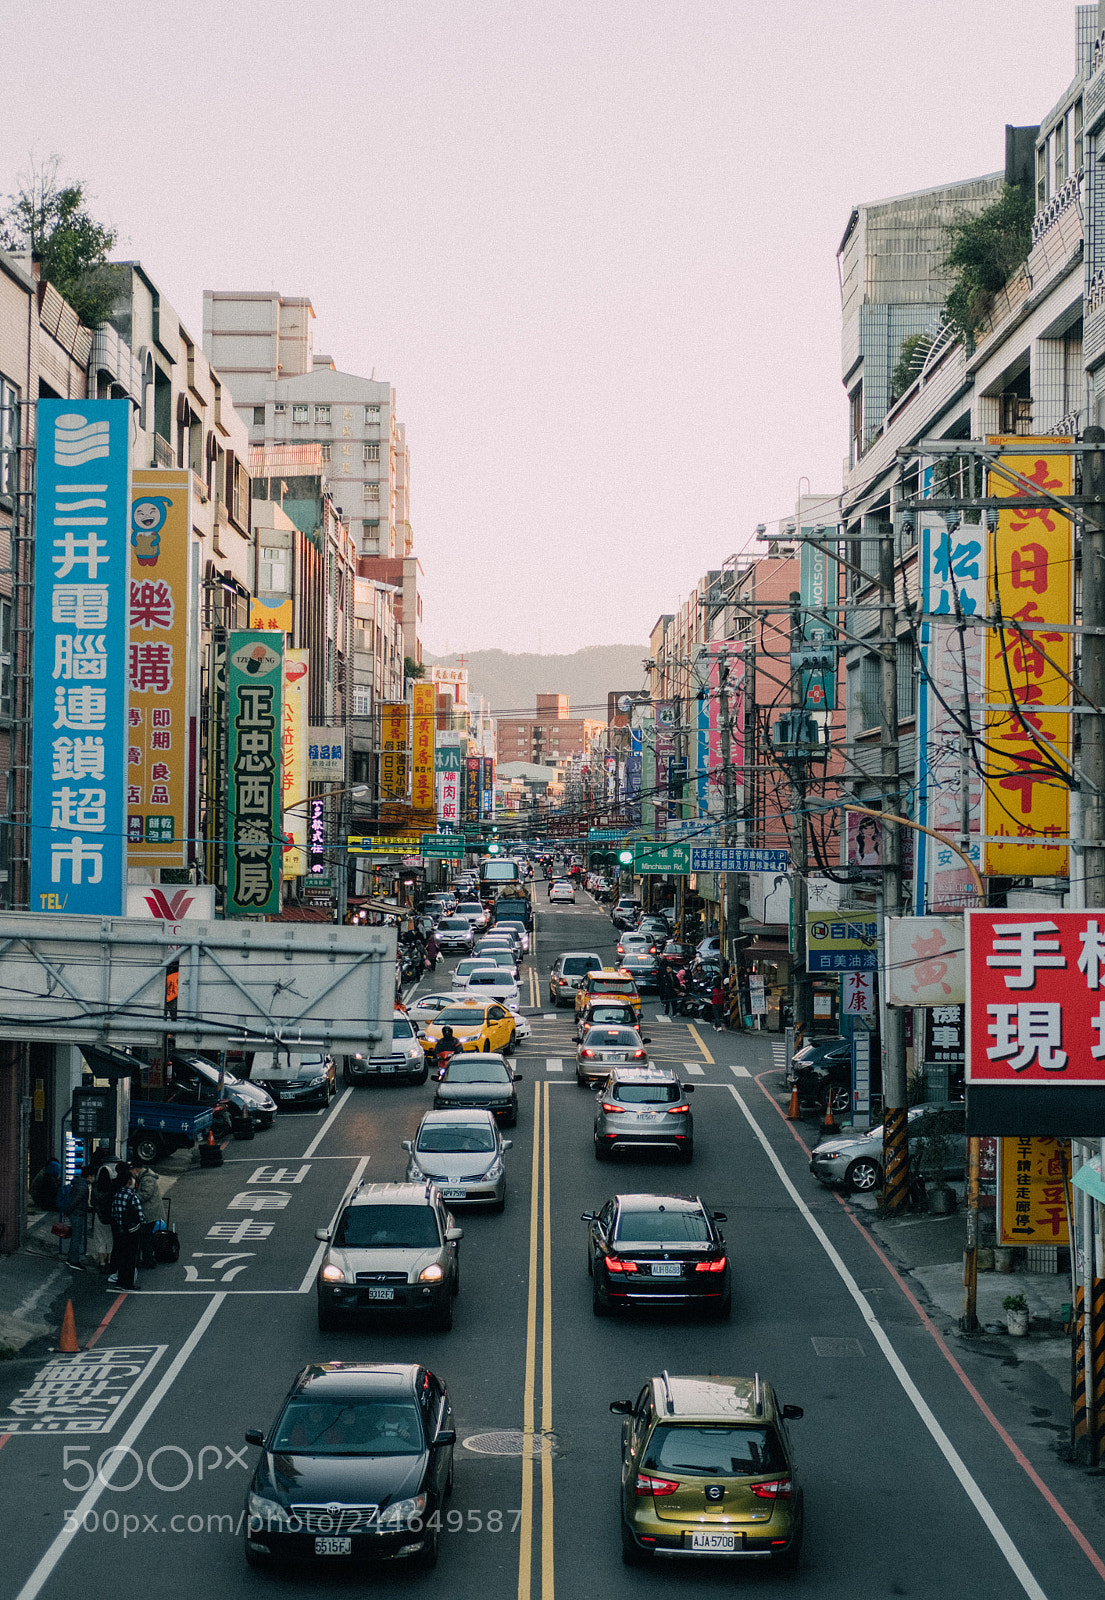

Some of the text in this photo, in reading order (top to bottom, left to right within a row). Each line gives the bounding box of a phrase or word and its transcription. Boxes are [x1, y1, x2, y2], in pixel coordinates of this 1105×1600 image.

[51, 484, 109, 885] 三井電腦連鎖超市
[994, 459, 1065, 814] 黃日香豆干
[237, 687, 274, 905] 正忠西藥房
[416, 718, 432, 765] 黃日香
[416, 774, 431, 804] 豆干
[820, 955, 876, 968] 百美油漆
